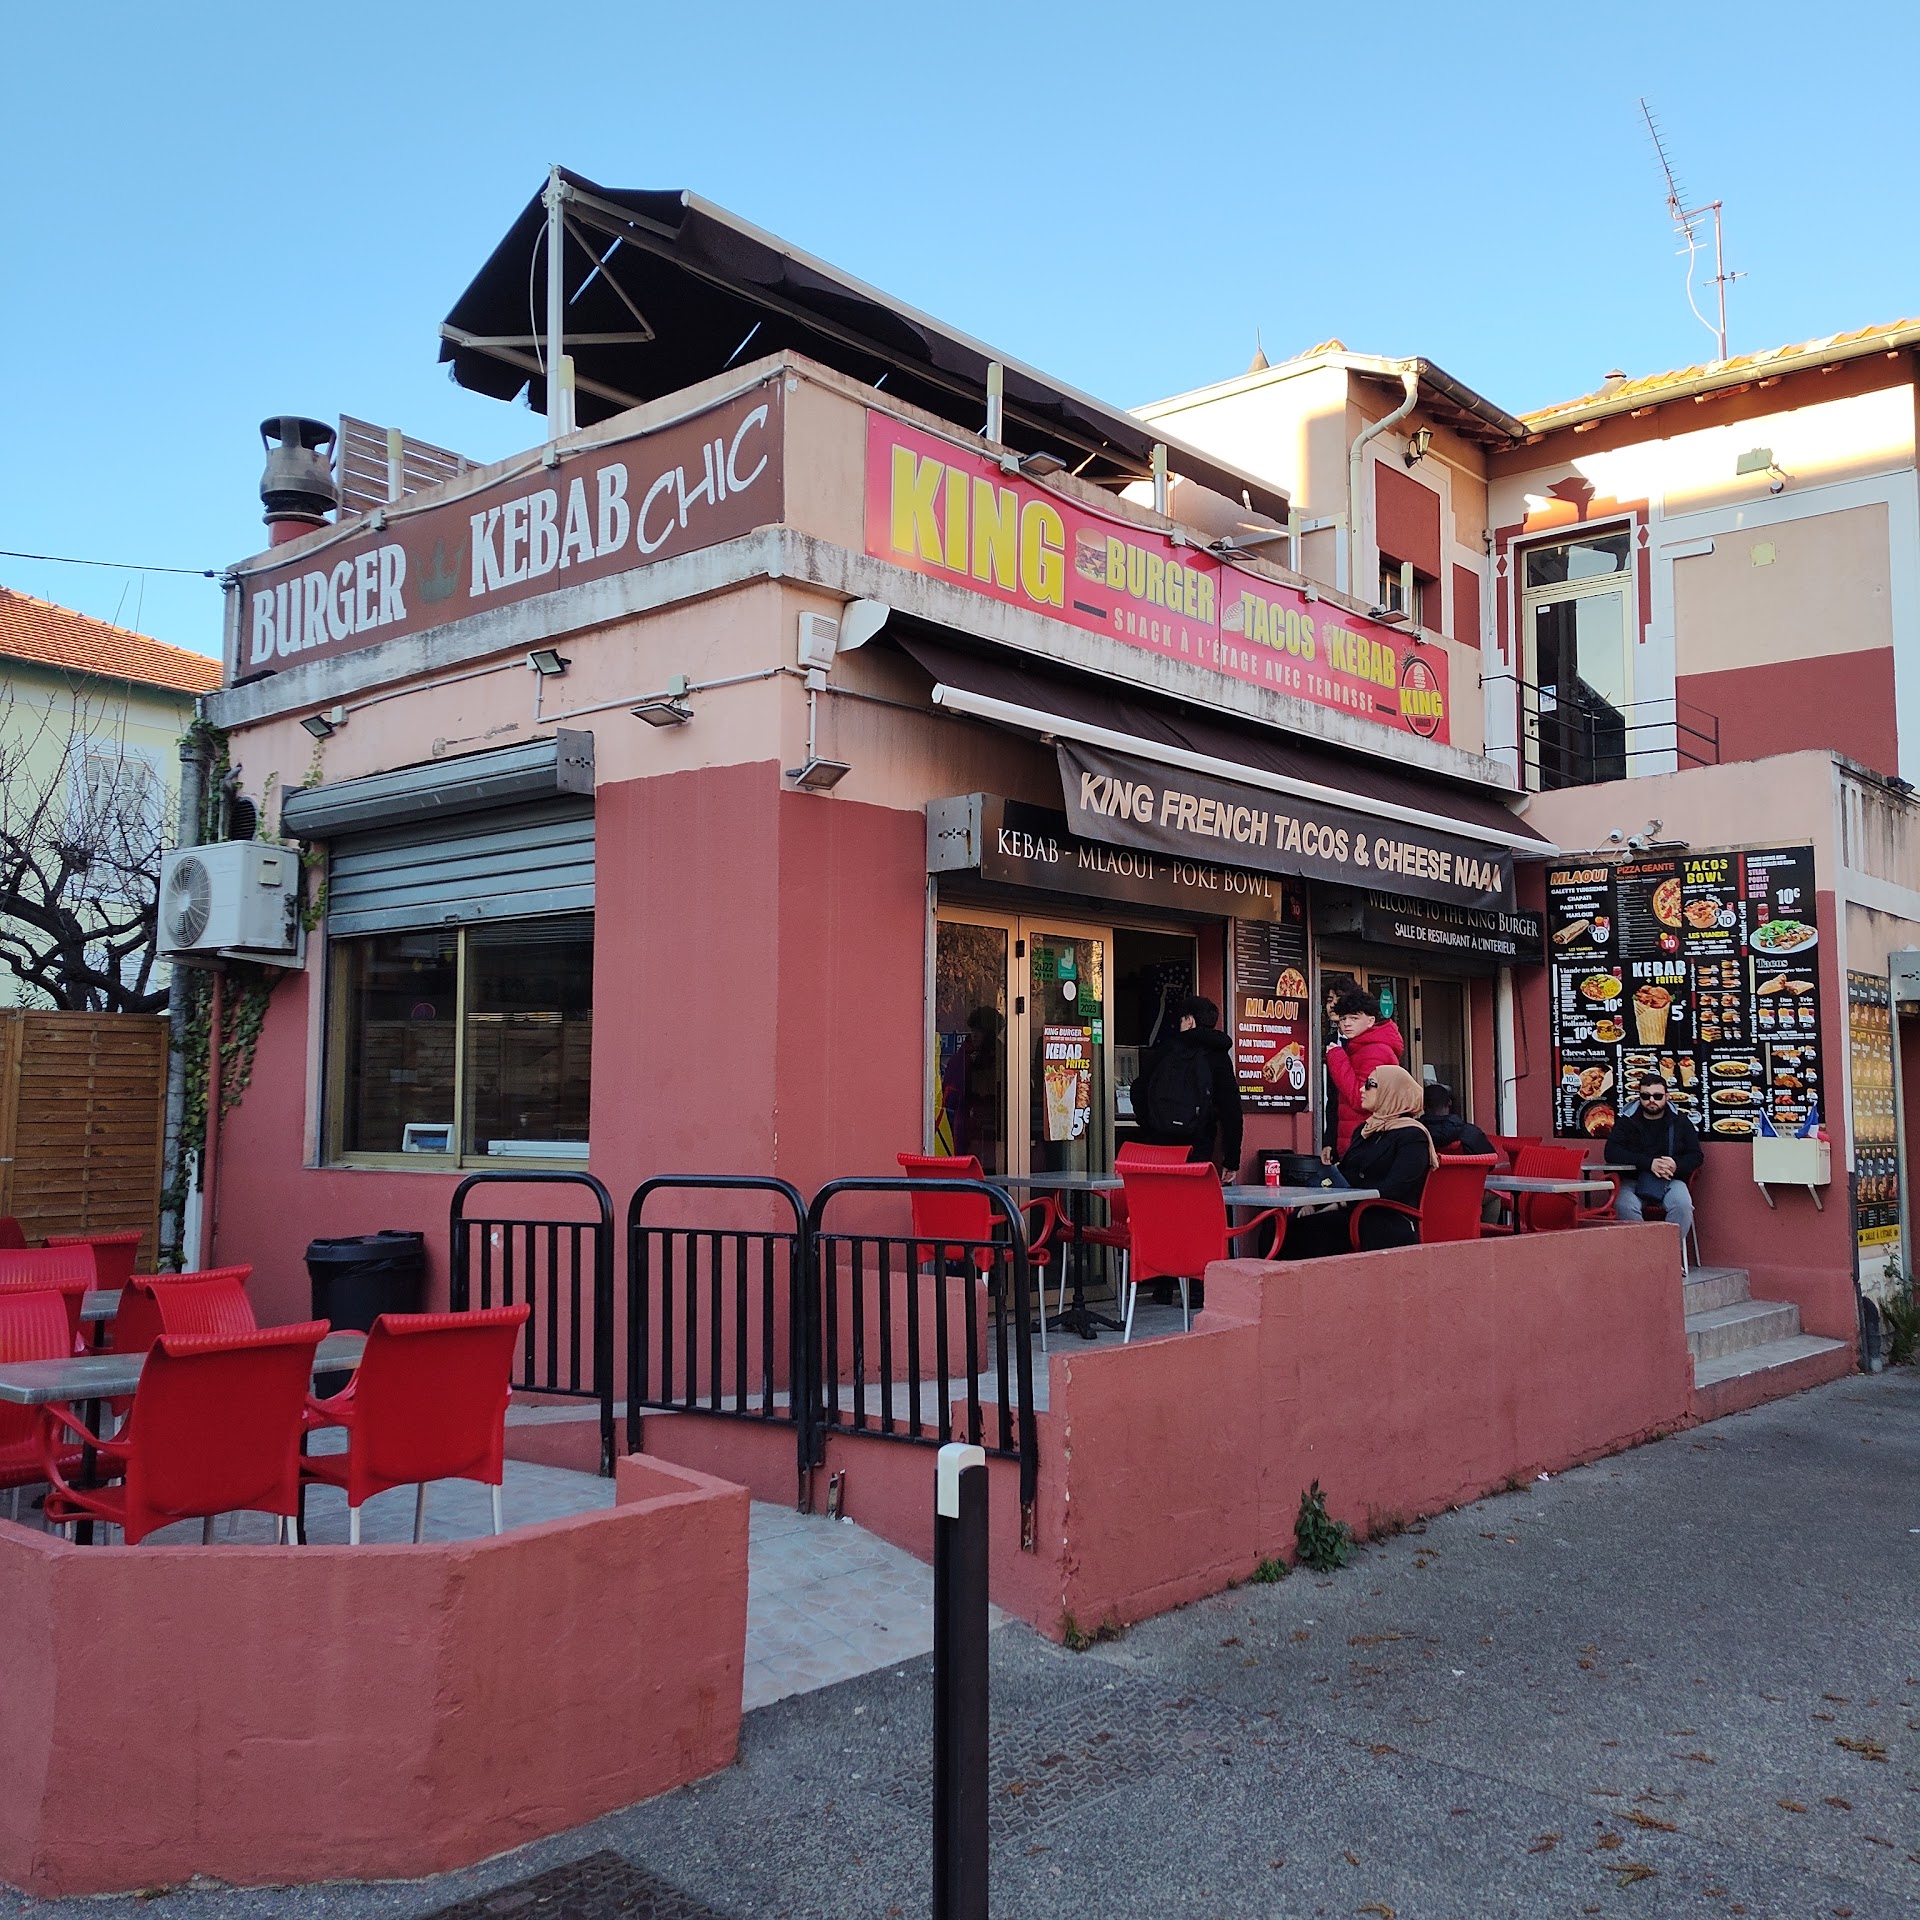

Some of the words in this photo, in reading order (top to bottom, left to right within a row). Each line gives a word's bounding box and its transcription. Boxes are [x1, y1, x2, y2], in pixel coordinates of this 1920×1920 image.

[250, 543, 407, 665] BURGER
[469, 462, 631, 597] KEBAB
[637, 403, 769, 554] CHIC
[891, 443, 1066, 609] KING
[1106, 535, 1217, 626] BURGER
[1240, 591, 1315, 662] TACOS
[1114, 607, 1172, 647] SNACK
[1180, 626, 1189, 654] À
[1197, 639, 1258, 676] L'ÉTAGE
[1265, 660, 1301, 689] AVEC
[1307, 674, 1374, 714] TERRASSE
[1331, 624, 1397, 690] KEBAB
[1399, 687, 1444, 719] KING
[1080, 771, 1155, 823] KING
[1160, 789, 1269, 847] FRENCH
[1274, 814, 1349, 863] TACOS
[1353, 838, 1370, 867] &
[1374, 838, 1451, 883] CHEESE
[1454, 855, 1503, 893] NAAN
[997, 827, 1060, 863] KEBAB
[1077, 844, 1154, 880] MLAOUI
[1172, 859, 1219, 890] POKE
[1223, 870, 1273, 899] BOWL
[1616, 864, 1640, 874] PIZZA
[1641, 862, 1675, 873] GEANTE
[1683, 859, 1728, 872] TACOS
[1550, 868, 1608, 885] MLAOUI
[1687, 871, 1725, 884] BOWL
[1292, 904, 1301, 915] 10
[1368, 889, 1422, 918] WELCOME
[1425, 901, 1440, 920] TO
[1442, 905, 1463, 925] THE
[1394, 922, 1415, 938] SALLE
[1416, 927, 1427, 941] DE
[1427, 928, 1471, 948] RESTAURANT
[1664, 940, 1675, 948] 10
[1632, 960, 1686, 977] KEBAB
[1656, 976, 1684, 984] FRITES
[1080, 1003, 1097, 1014] 2023
[1245, 998, 1299, 1020] MLAOUI
[1044, 1028, 1058, 1036] KING
[1045, 1043, 1082, 1060] KEBAB
[1065, 1059, 1090, 1069] FRITES
